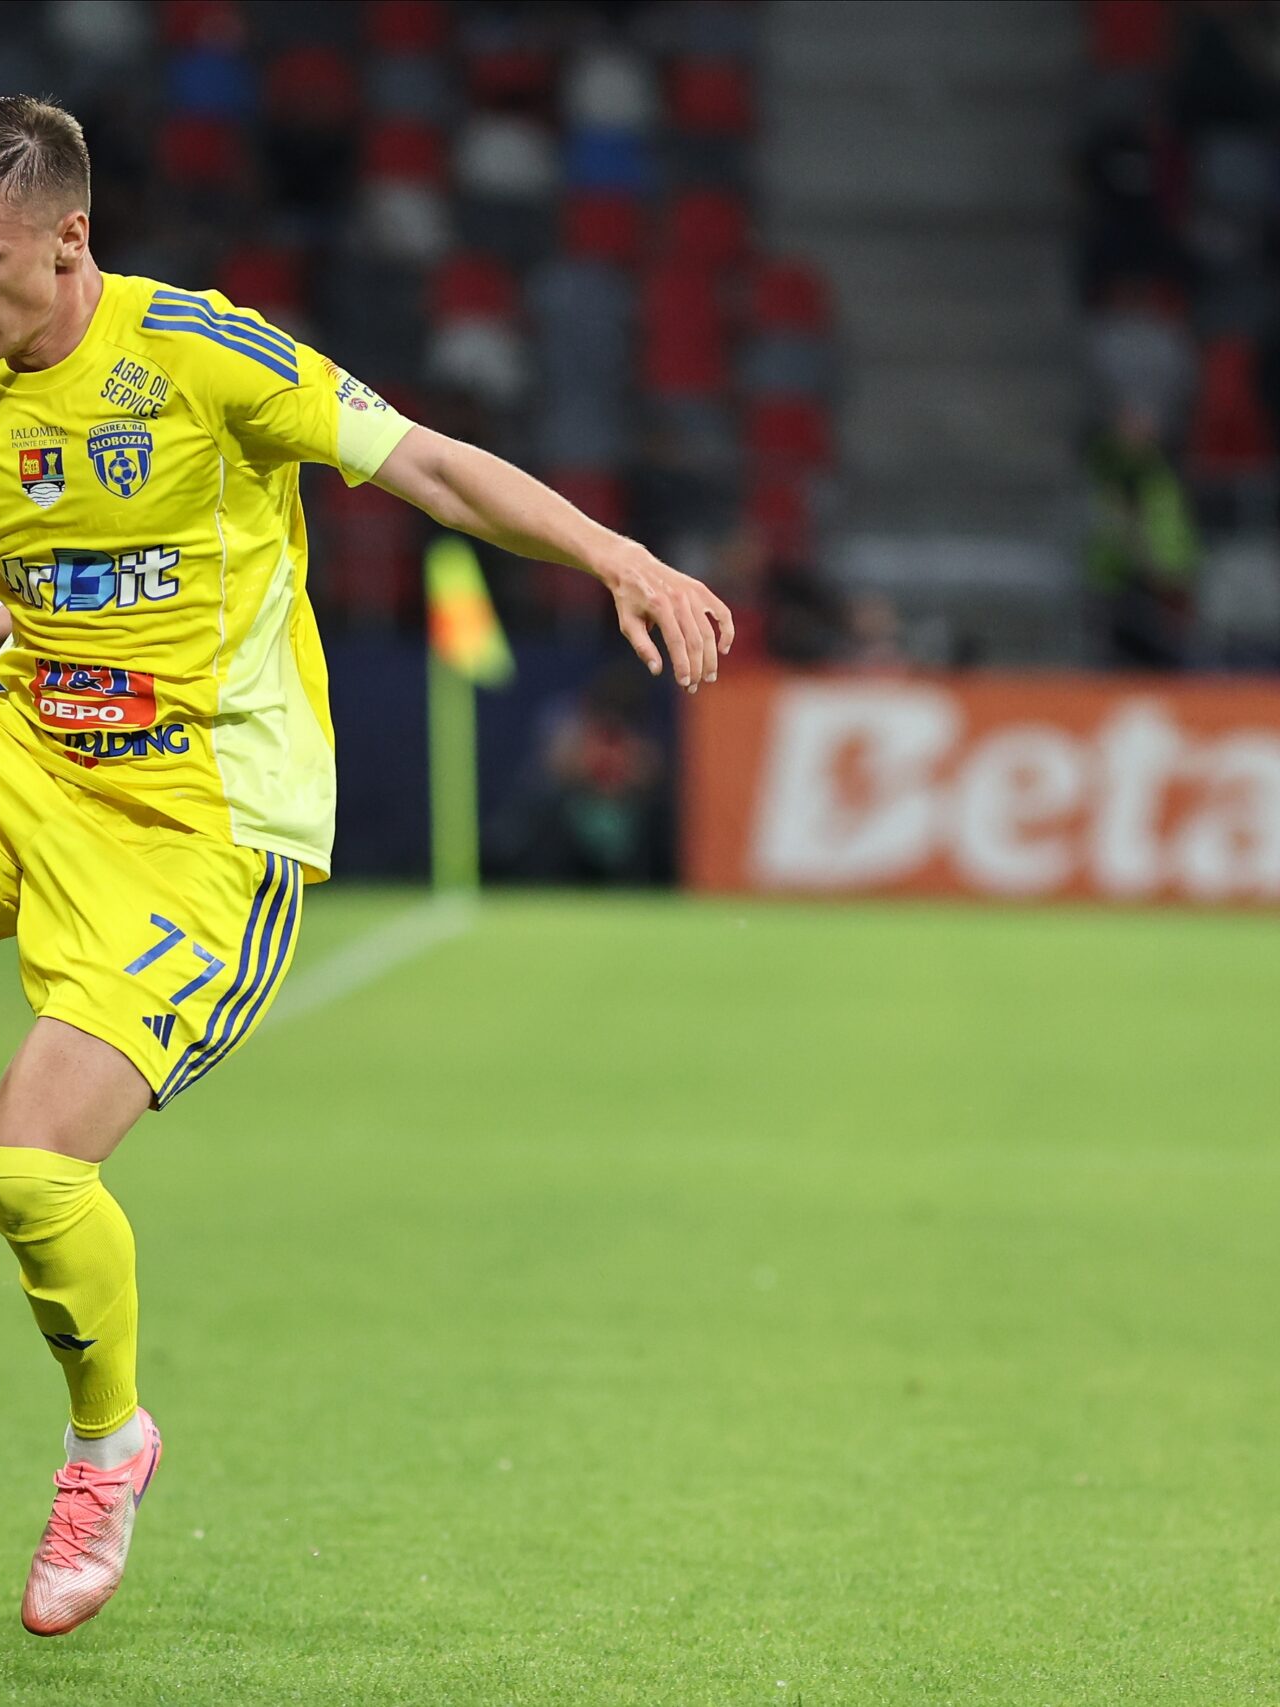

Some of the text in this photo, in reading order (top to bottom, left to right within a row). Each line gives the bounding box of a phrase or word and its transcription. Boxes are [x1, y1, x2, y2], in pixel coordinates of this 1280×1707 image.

[111, 356, 169, 402] AGRO OIL
[100, 377, 163, 420] SERVICE
[92, 423, 127, 436] UNIREA
[38, 439, 48, 447] DE
[89, 434, 151, 452] SLOBOZIA
[39, 698, 125, 722] DEPO
[123, 912, 227, 1007] 77
